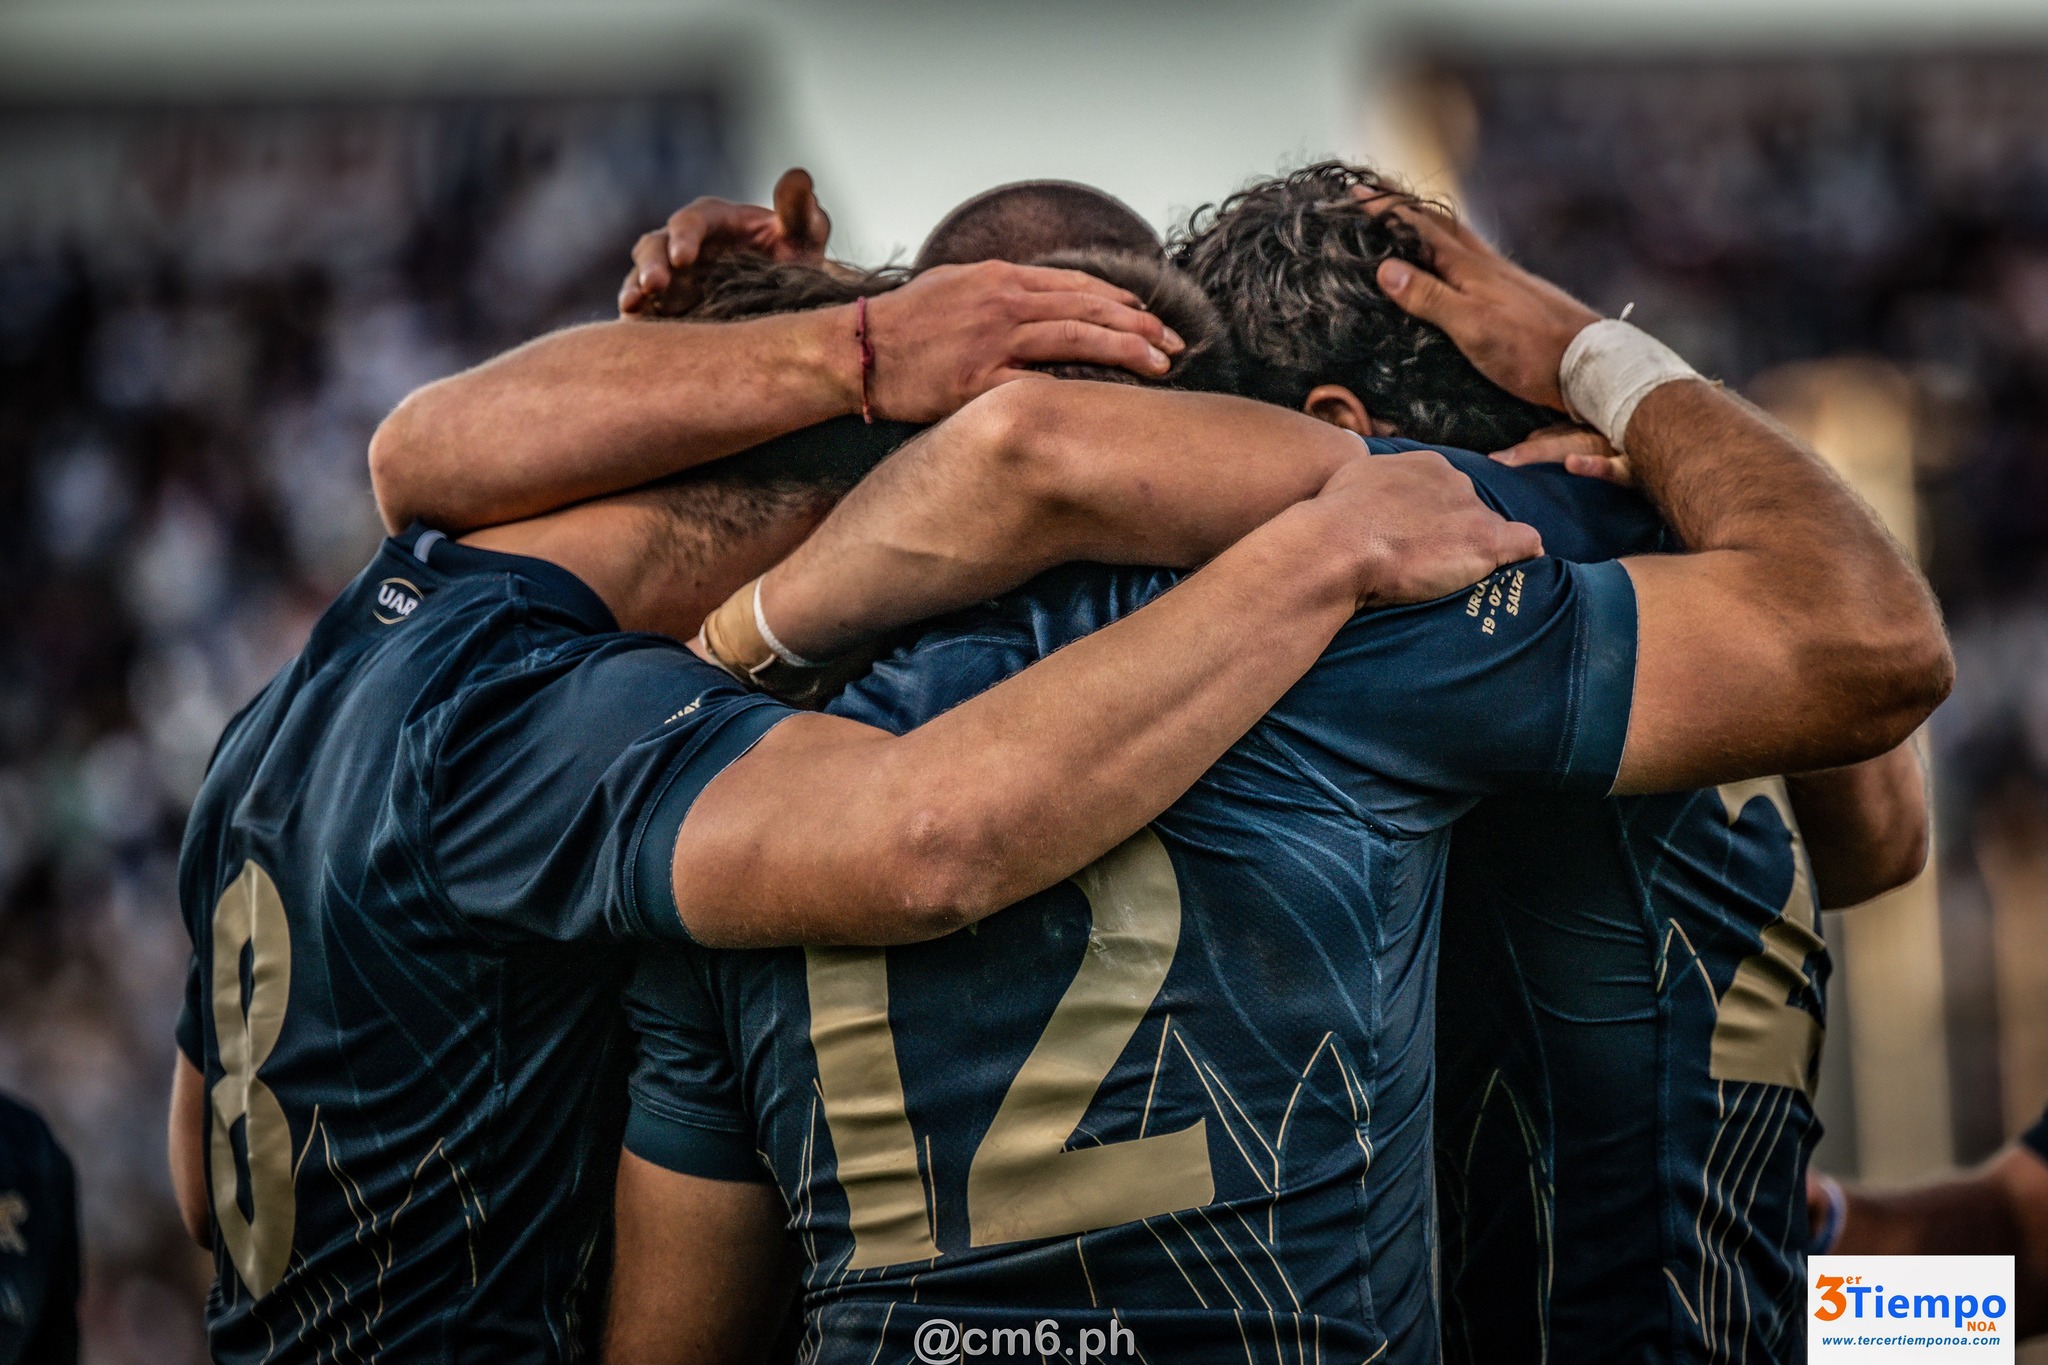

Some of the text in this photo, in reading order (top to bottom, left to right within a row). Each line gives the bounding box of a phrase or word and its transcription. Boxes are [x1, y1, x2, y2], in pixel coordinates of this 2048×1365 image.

[378, 584, 418, 616] UAR
[1506, 569, 1526, 617] SALTA
[211, 858, 296, 1301] 8
[804, 824, 1216, 1271] 12
